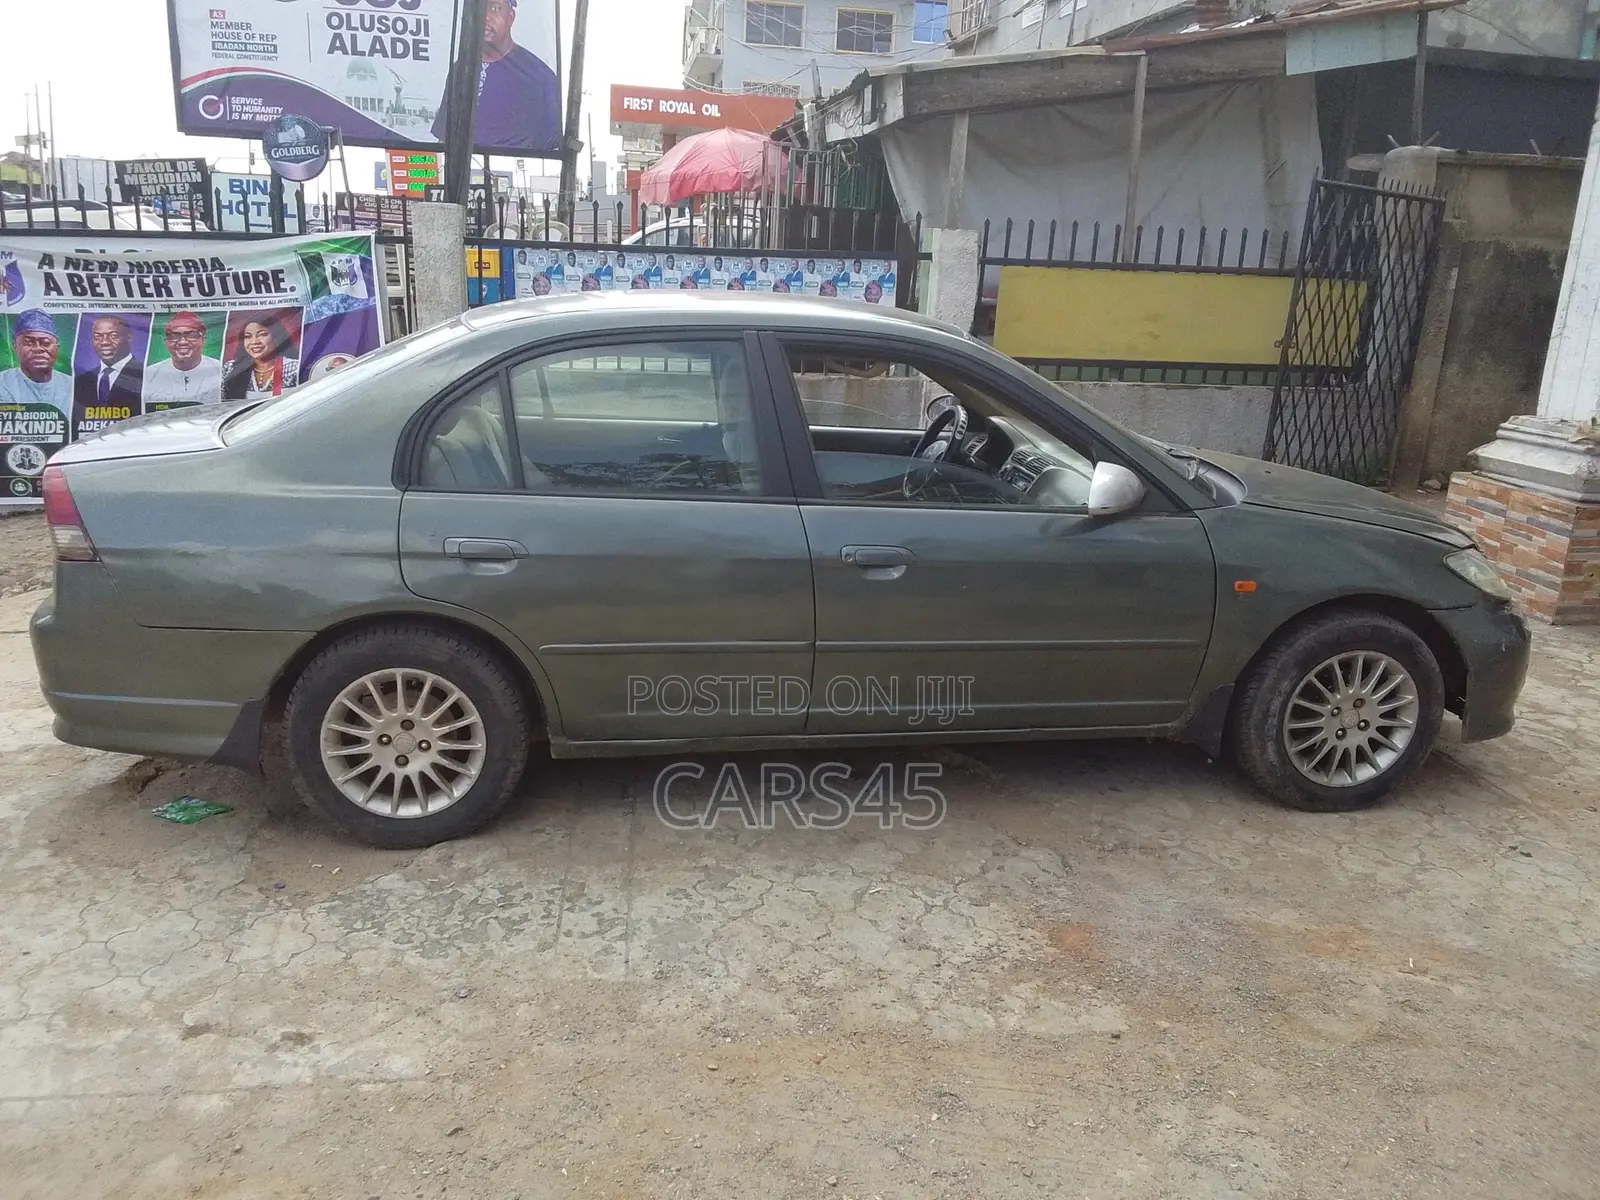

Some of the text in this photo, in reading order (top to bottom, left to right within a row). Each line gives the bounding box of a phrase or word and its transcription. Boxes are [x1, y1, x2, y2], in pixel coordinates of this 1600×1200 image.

[212, 10, 224, 19] AS
[210, 21, 252, 31] MEMBER
[326, 11, 430, 37] OLUSOJI
[211, 31, 277, 43] HOUSE OF REP
[214, 42, 274, 53] IBADAN NORTH
[327, 32, 430, 61] ALADE
[212, 52, 278, 61] FEDERAL CONSTITUENCY
[231, 97, 263, 105] SERVICE
[624, 97, 721, 117] FIRST ROYAL OIL
[232, 104, 283, 114] TO HUMANITY
[256, 114, 281, 122] MOTT
[271, 145, 320, 158] GOLDBERG
[125, 161, 197, 173] FAKOL DE
[124, 172, 202, 185] MERIDIAN
[220, 199, 297, 219] HOTL
[37, 252, 234, 274] A NEW NIGERIA.
[43, 268, 297, 298] A BETTER FUTURE.
[14, 411, 59, 420] ABIODUN
[85, 407, 131, 419] BIMBO
[0, 420, 65, 434] AKINDE
